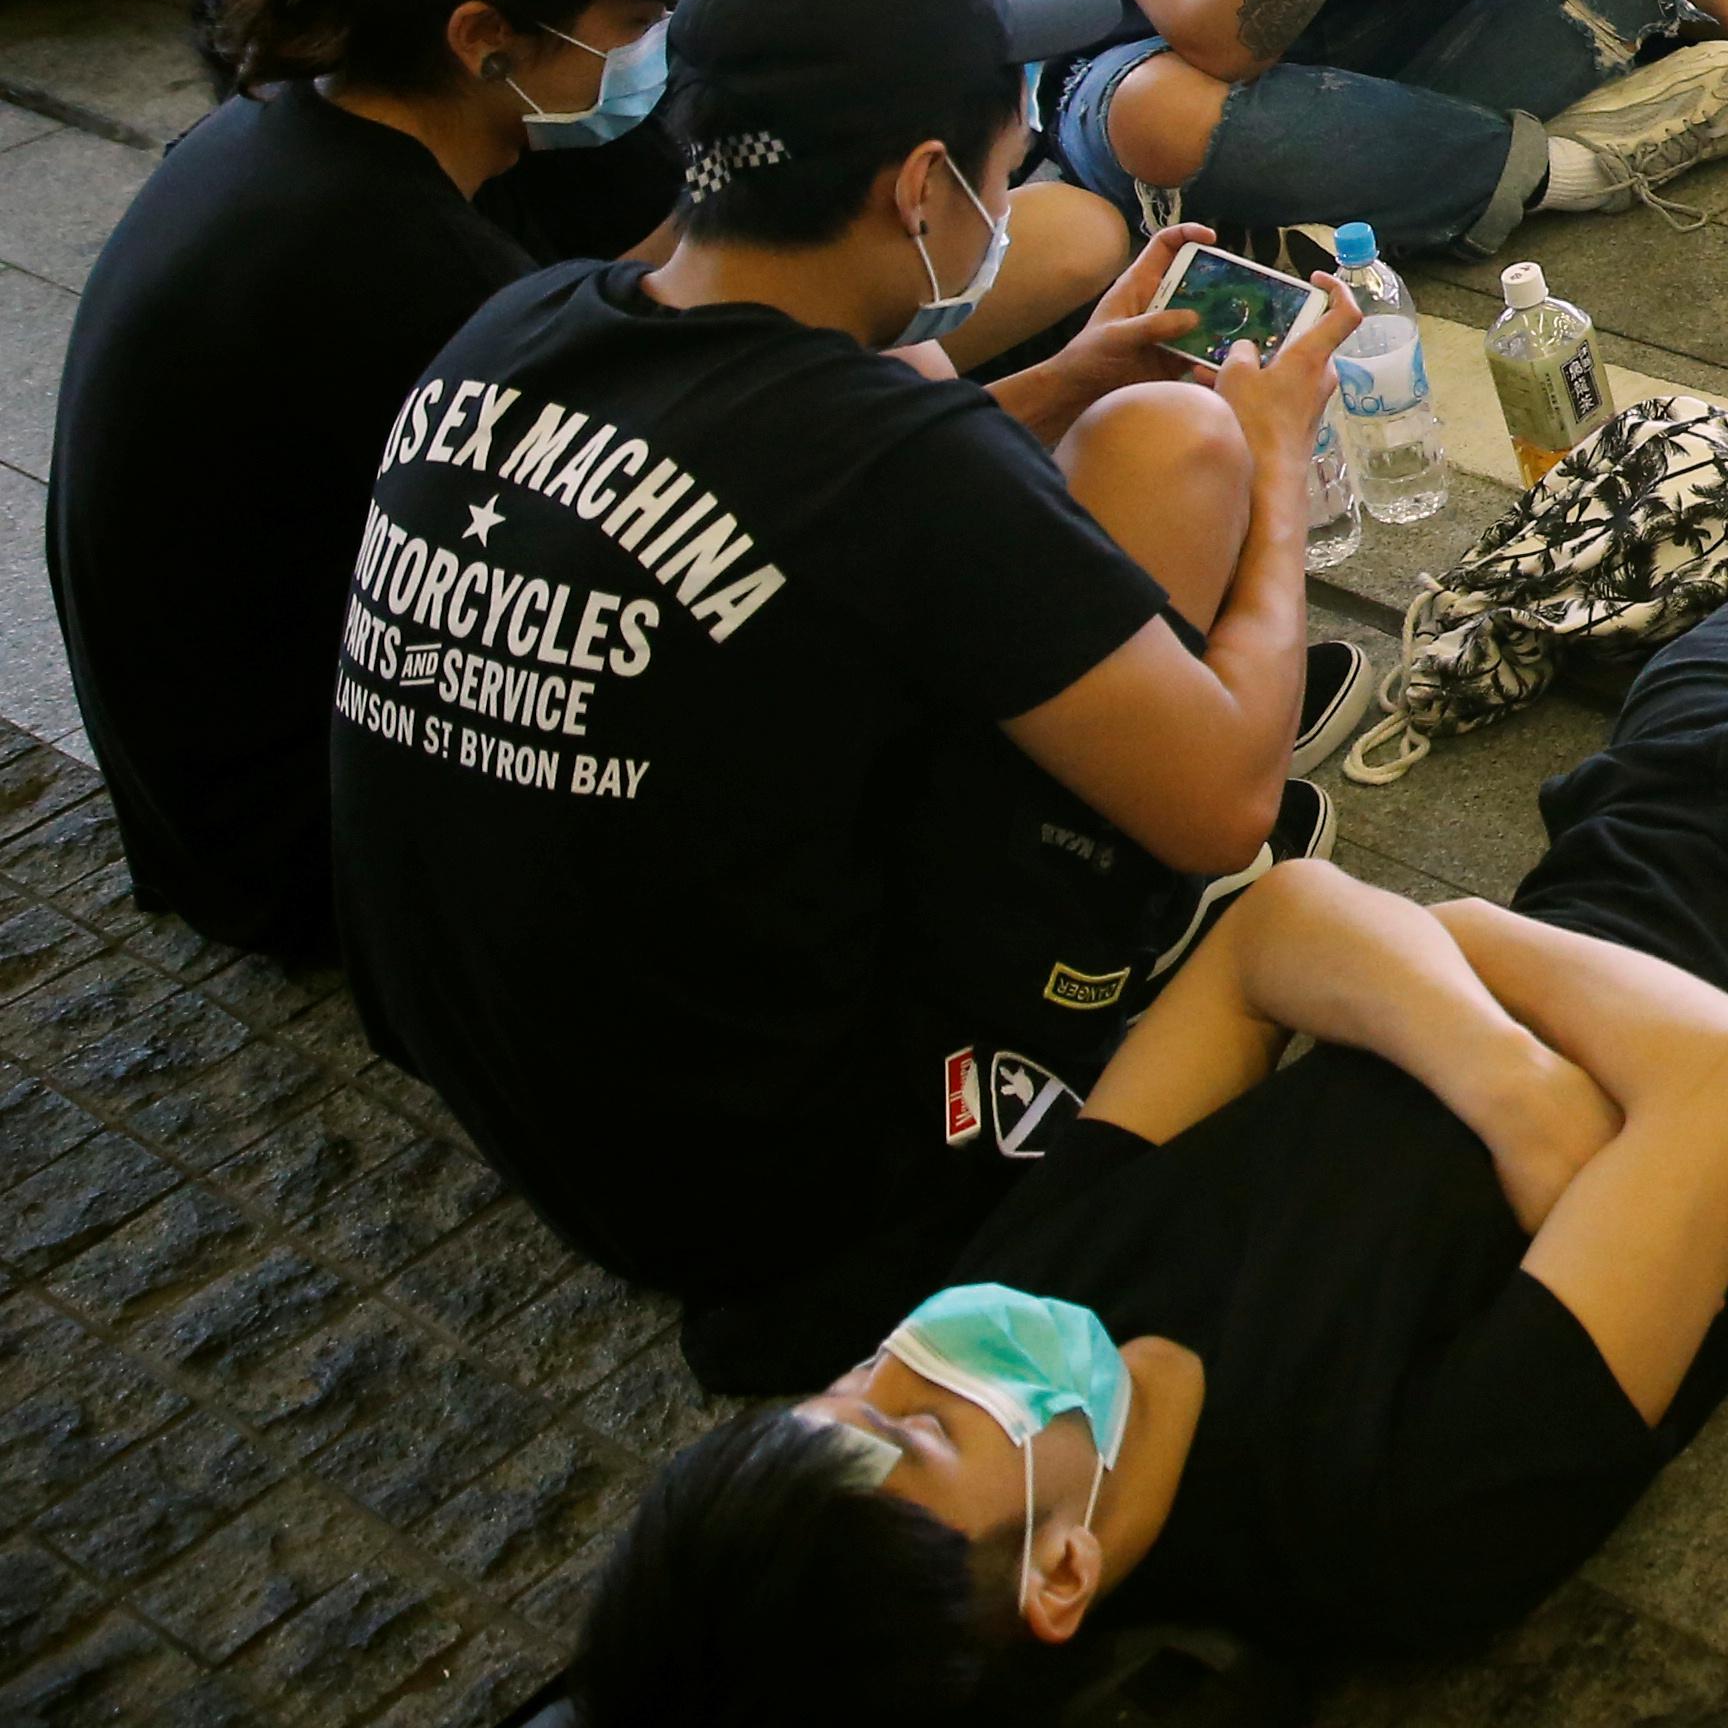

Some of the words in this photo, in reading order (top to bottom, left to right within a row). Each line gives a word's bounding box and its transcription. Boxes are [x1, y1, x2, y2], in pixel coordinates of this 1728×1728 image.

[354, 498, 660, 677] MOTORCYCLES
[377, 378, 444, 474] US
[426, 379, 522, 472] EX
[498, 402, 787, 644] MACHINA
[335, 669, 415, 747] LAWSON
[460, 727, 560, 790] BYRON
[571, 754, 650, 799] BAY
[344, 593, 401, 679] PARTS
[402, 650, 439, 679] AND
[439, 648, 595, 736] SERVICE
